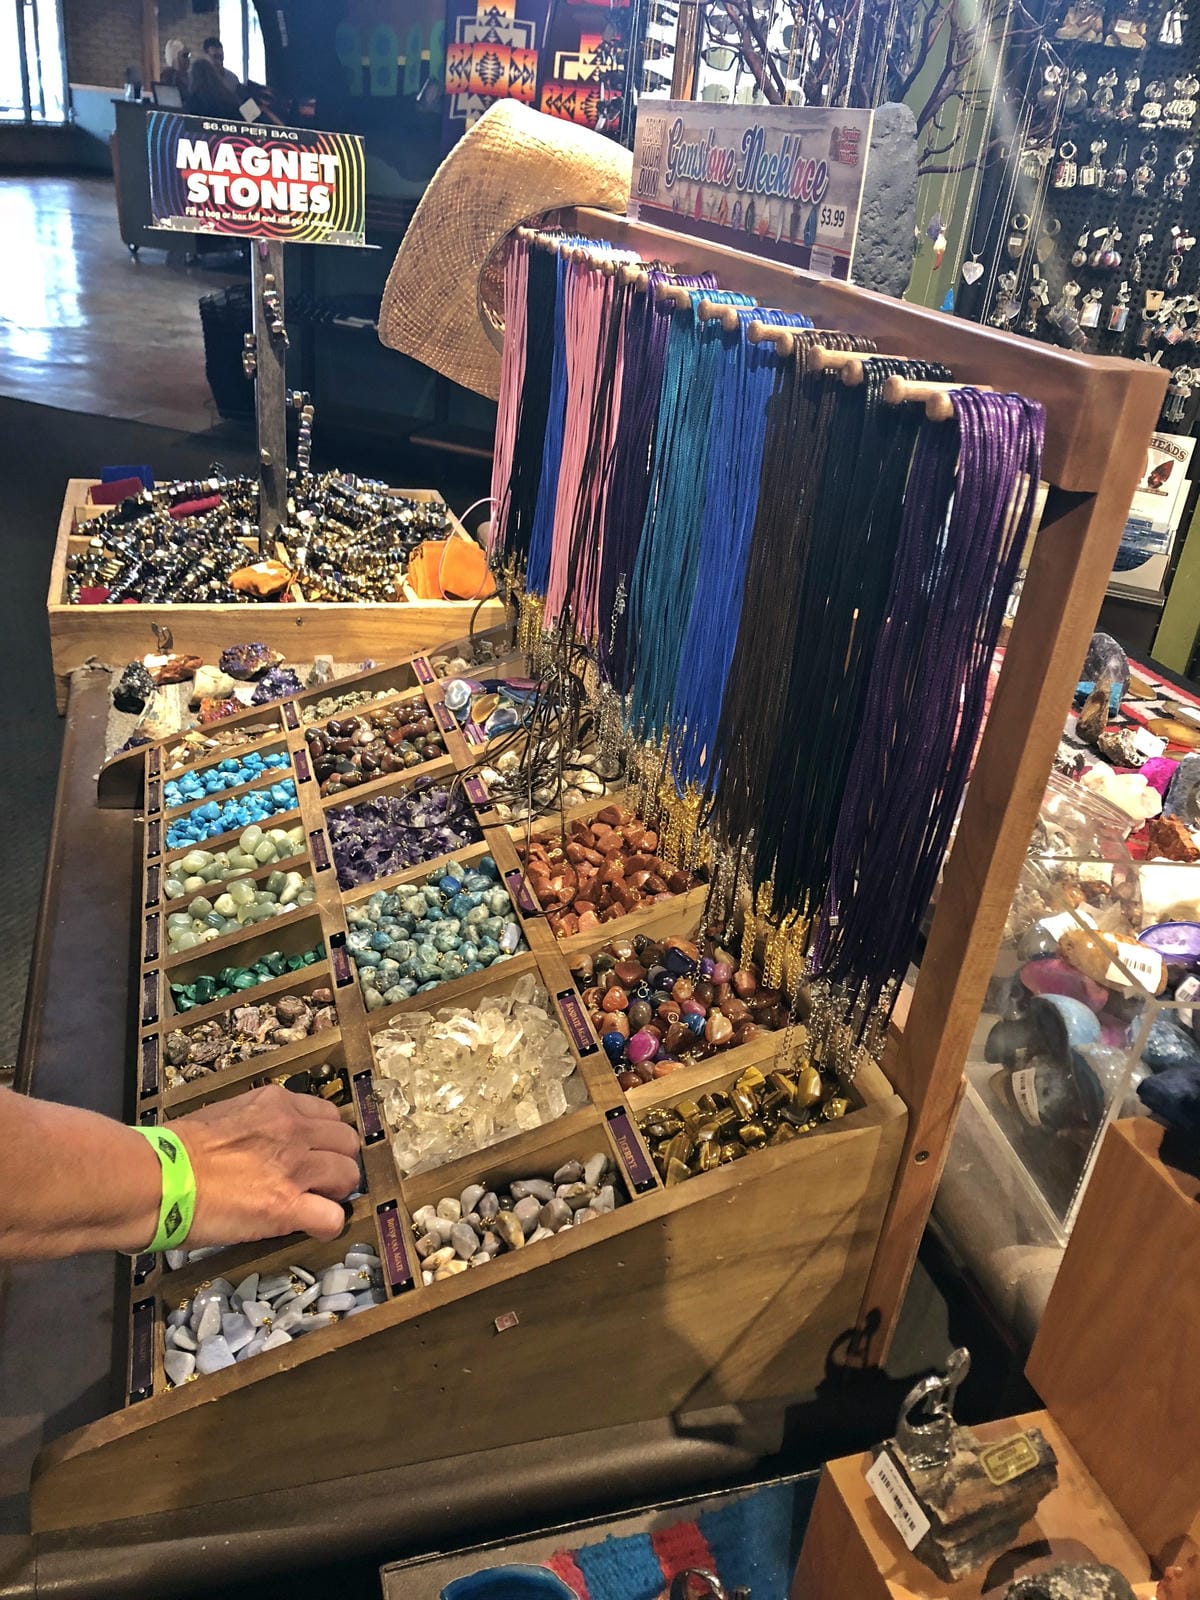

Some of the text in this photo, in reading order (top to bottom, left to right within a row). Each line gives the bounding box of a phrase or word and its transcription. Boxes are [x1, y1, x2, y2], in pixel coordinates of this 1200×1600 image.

[202, 121, 299, 140] $6.98 PER BAG
[176, 138, 339, 184] MAGNET
[640, 144, 661, 168] YOUR
[665, 116, 736, 187] Gemstone
[736, 122, 829, 204] Necklace
[186, 172, 331, 214] STONES
[637, 167, 659, 197] OWN
[185, 207, 197, 217] Fill
[205, 208, 221, 220] bag
[221, 211, 232, 219] or
[232, 210, 247, 221] box
[248, 211, 261, 222] full
[261, 213, 277, 223] and
[277, 214, 290, 224] still
[820, 207, 845, 228] $3.99
[577, 1027, 590, 1047] AGATE
[618, 1134, 637, 1169] TIGEREYE
[386, 1217, 404, 1272] BOTSWANA AGATE
